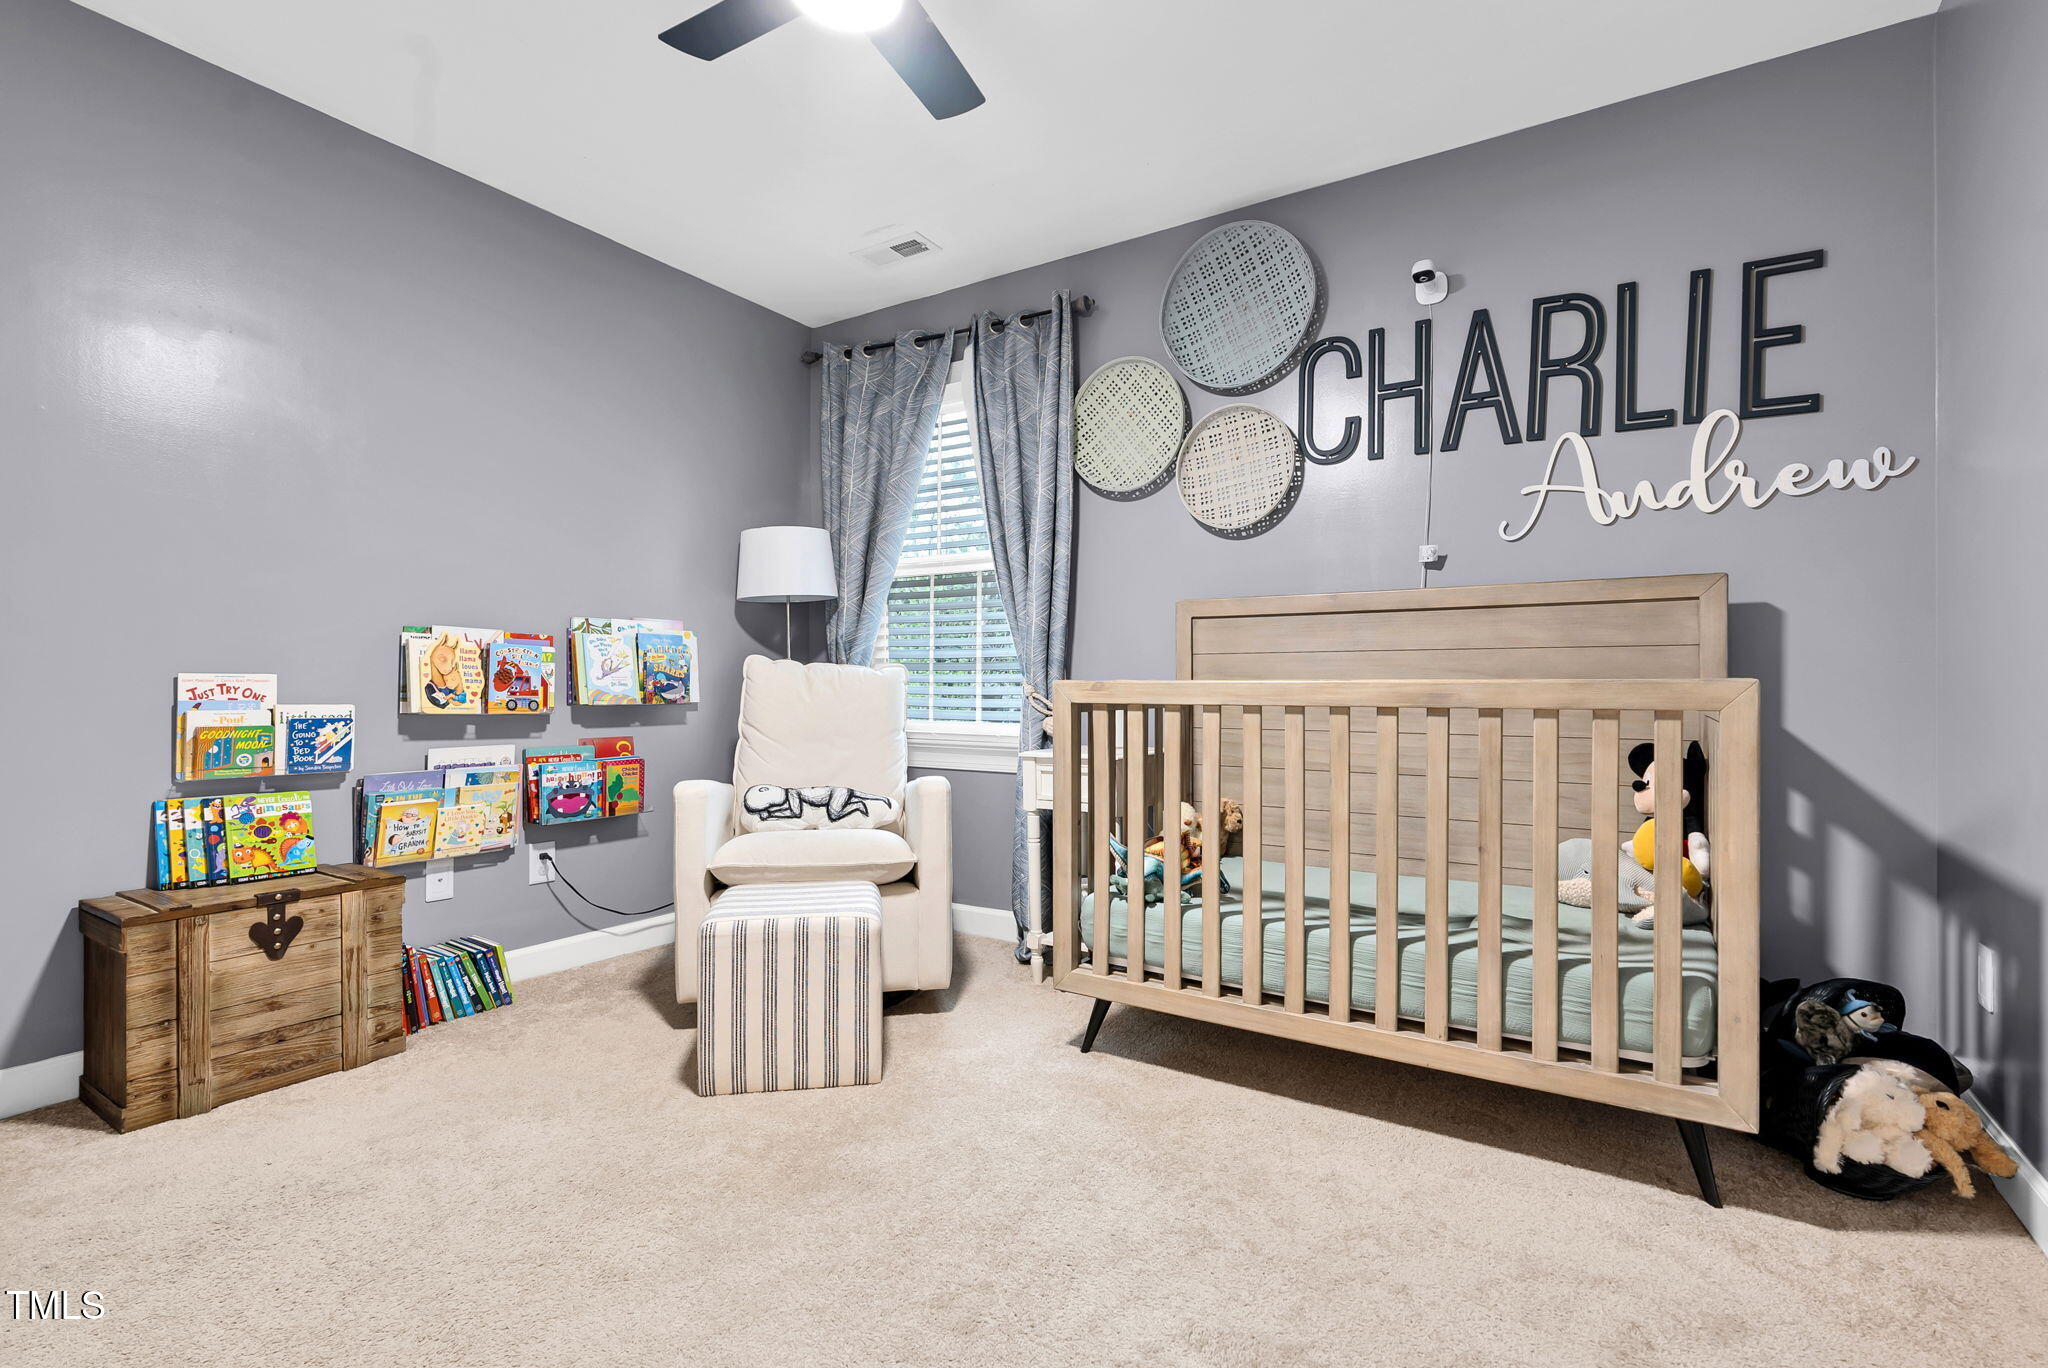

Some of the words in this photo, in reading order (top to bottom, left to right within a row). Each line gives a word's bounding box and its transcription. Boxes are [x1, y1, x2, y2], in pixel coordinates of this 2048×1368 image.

[1300, 249, 1825, 466] CHARLIE
[1498, 409, 1920, 543] Andrew
[460, 647, 477, 655] llama
[495, 647, 539, 659] CONSTRUCTION
[653, 663, 687, 679] SHARKS
[185, 686, 215, 701] JUST
[216, 683, 241, 695] TRY
[241, 687, 267, 703] ONE
[293, 721, 309, 730] THE
[199, 729, 263, 740] GOODNIGHT
[292, 731, 317, 740] GOING
[235, 740, 266, 750] MOON
[292, 746, 311, 755] BED
[292, 755, 315, 763] BOOK
[255, 802, 311, 815] dinosaurs
[405, 829, 427, 838] BABYSIT
[397, 840, 425, 850] GRANDPA
